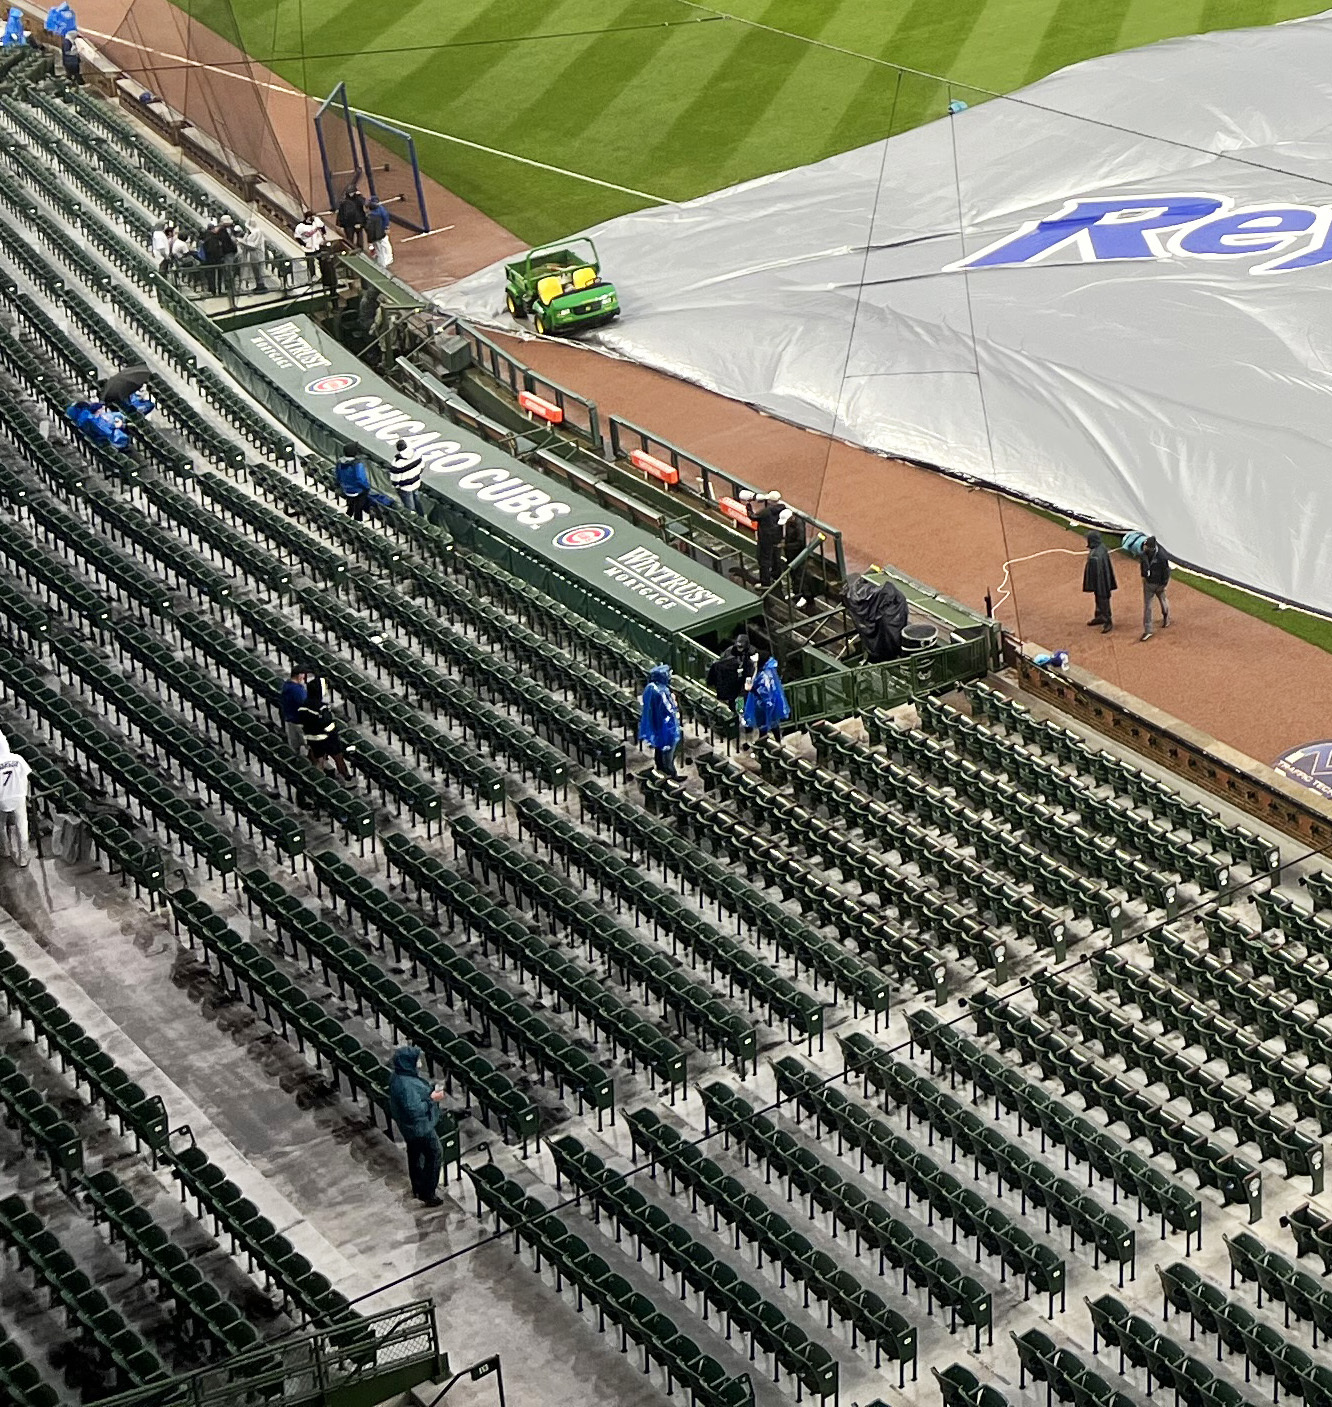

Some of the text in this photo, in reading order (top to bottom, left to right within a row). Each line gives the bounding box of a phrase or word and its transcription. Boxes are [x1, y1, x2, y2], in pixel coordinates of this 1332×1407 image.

[267, 322, 333, 369] WINTRUST
[332, 395, 572, 525] CHICAGO CUBS
[603, 566, 678, 611] MORTGAGE
[614, 546, 727, 610] WINTRUST
[2, 770, 13, 787] 7
